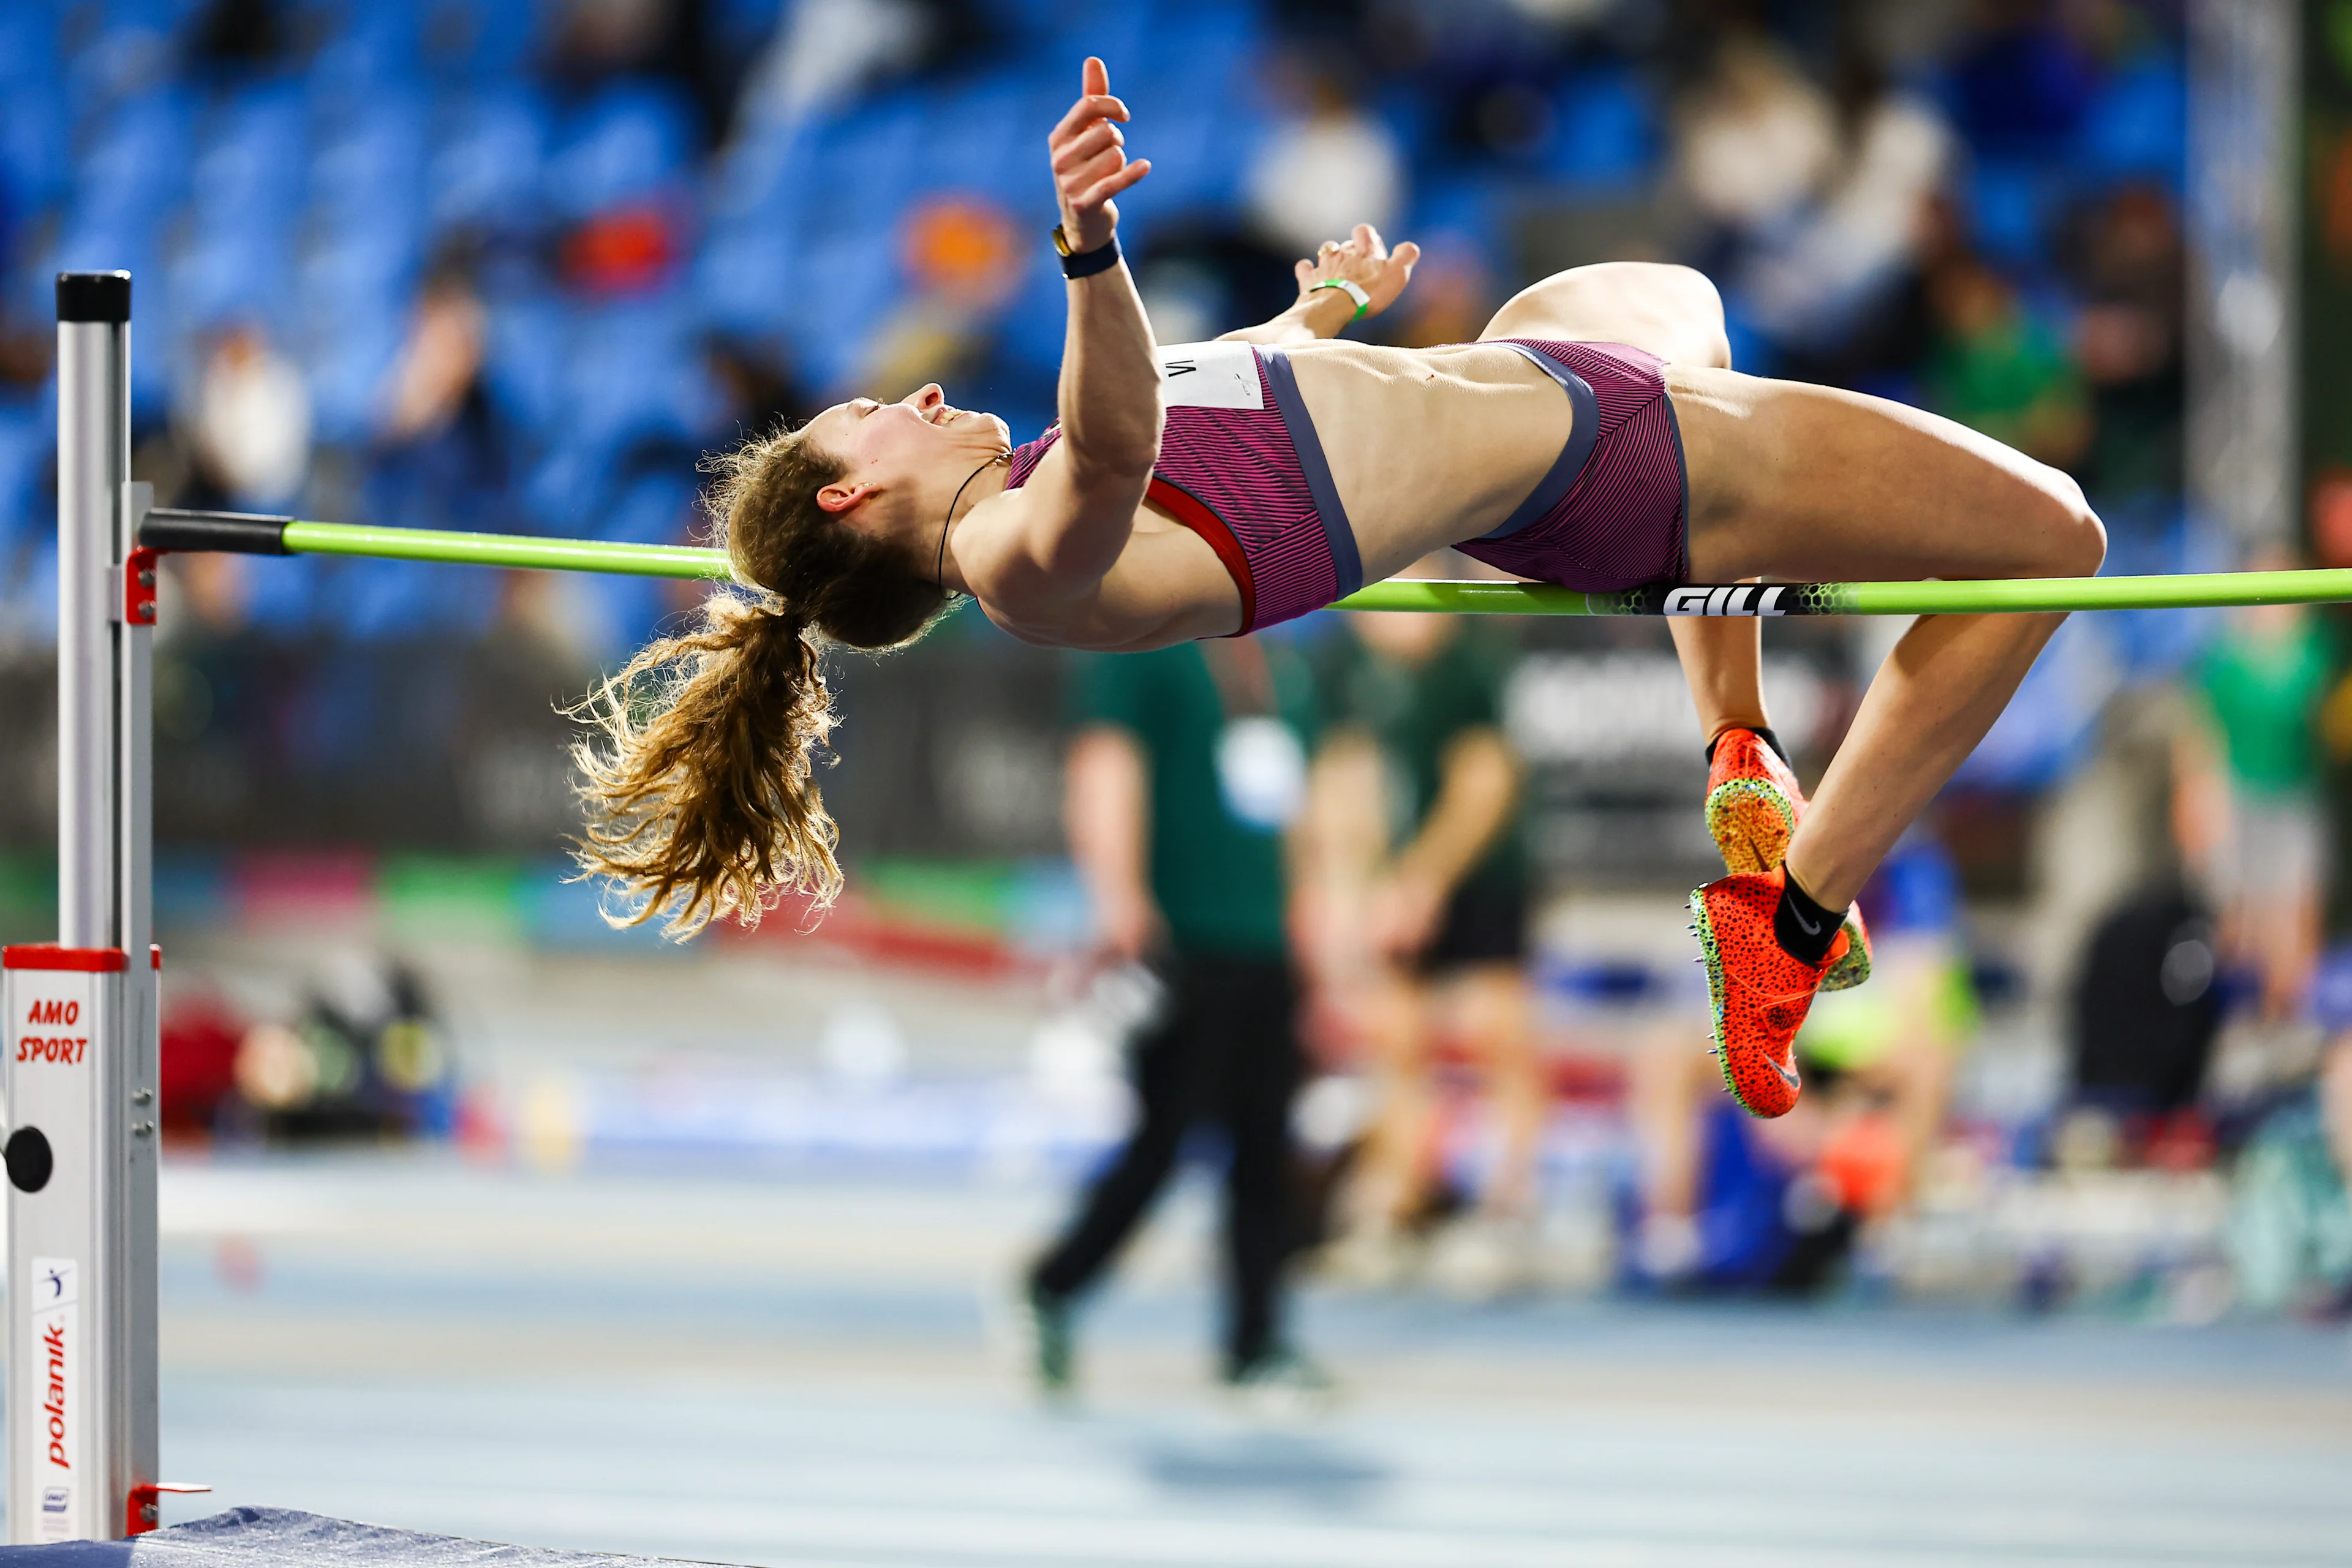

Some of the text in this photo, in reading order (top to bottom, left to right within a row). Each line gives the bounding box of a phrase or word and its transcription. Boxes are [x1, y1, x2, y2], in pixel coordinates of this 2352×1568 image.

[1663, 586, 1787, 616] GILL
[28, 1000, 79, 1026] AMO
[17, 1037, 88, 1065] SPORT
[43, 1324, 70, 1469] polanik
